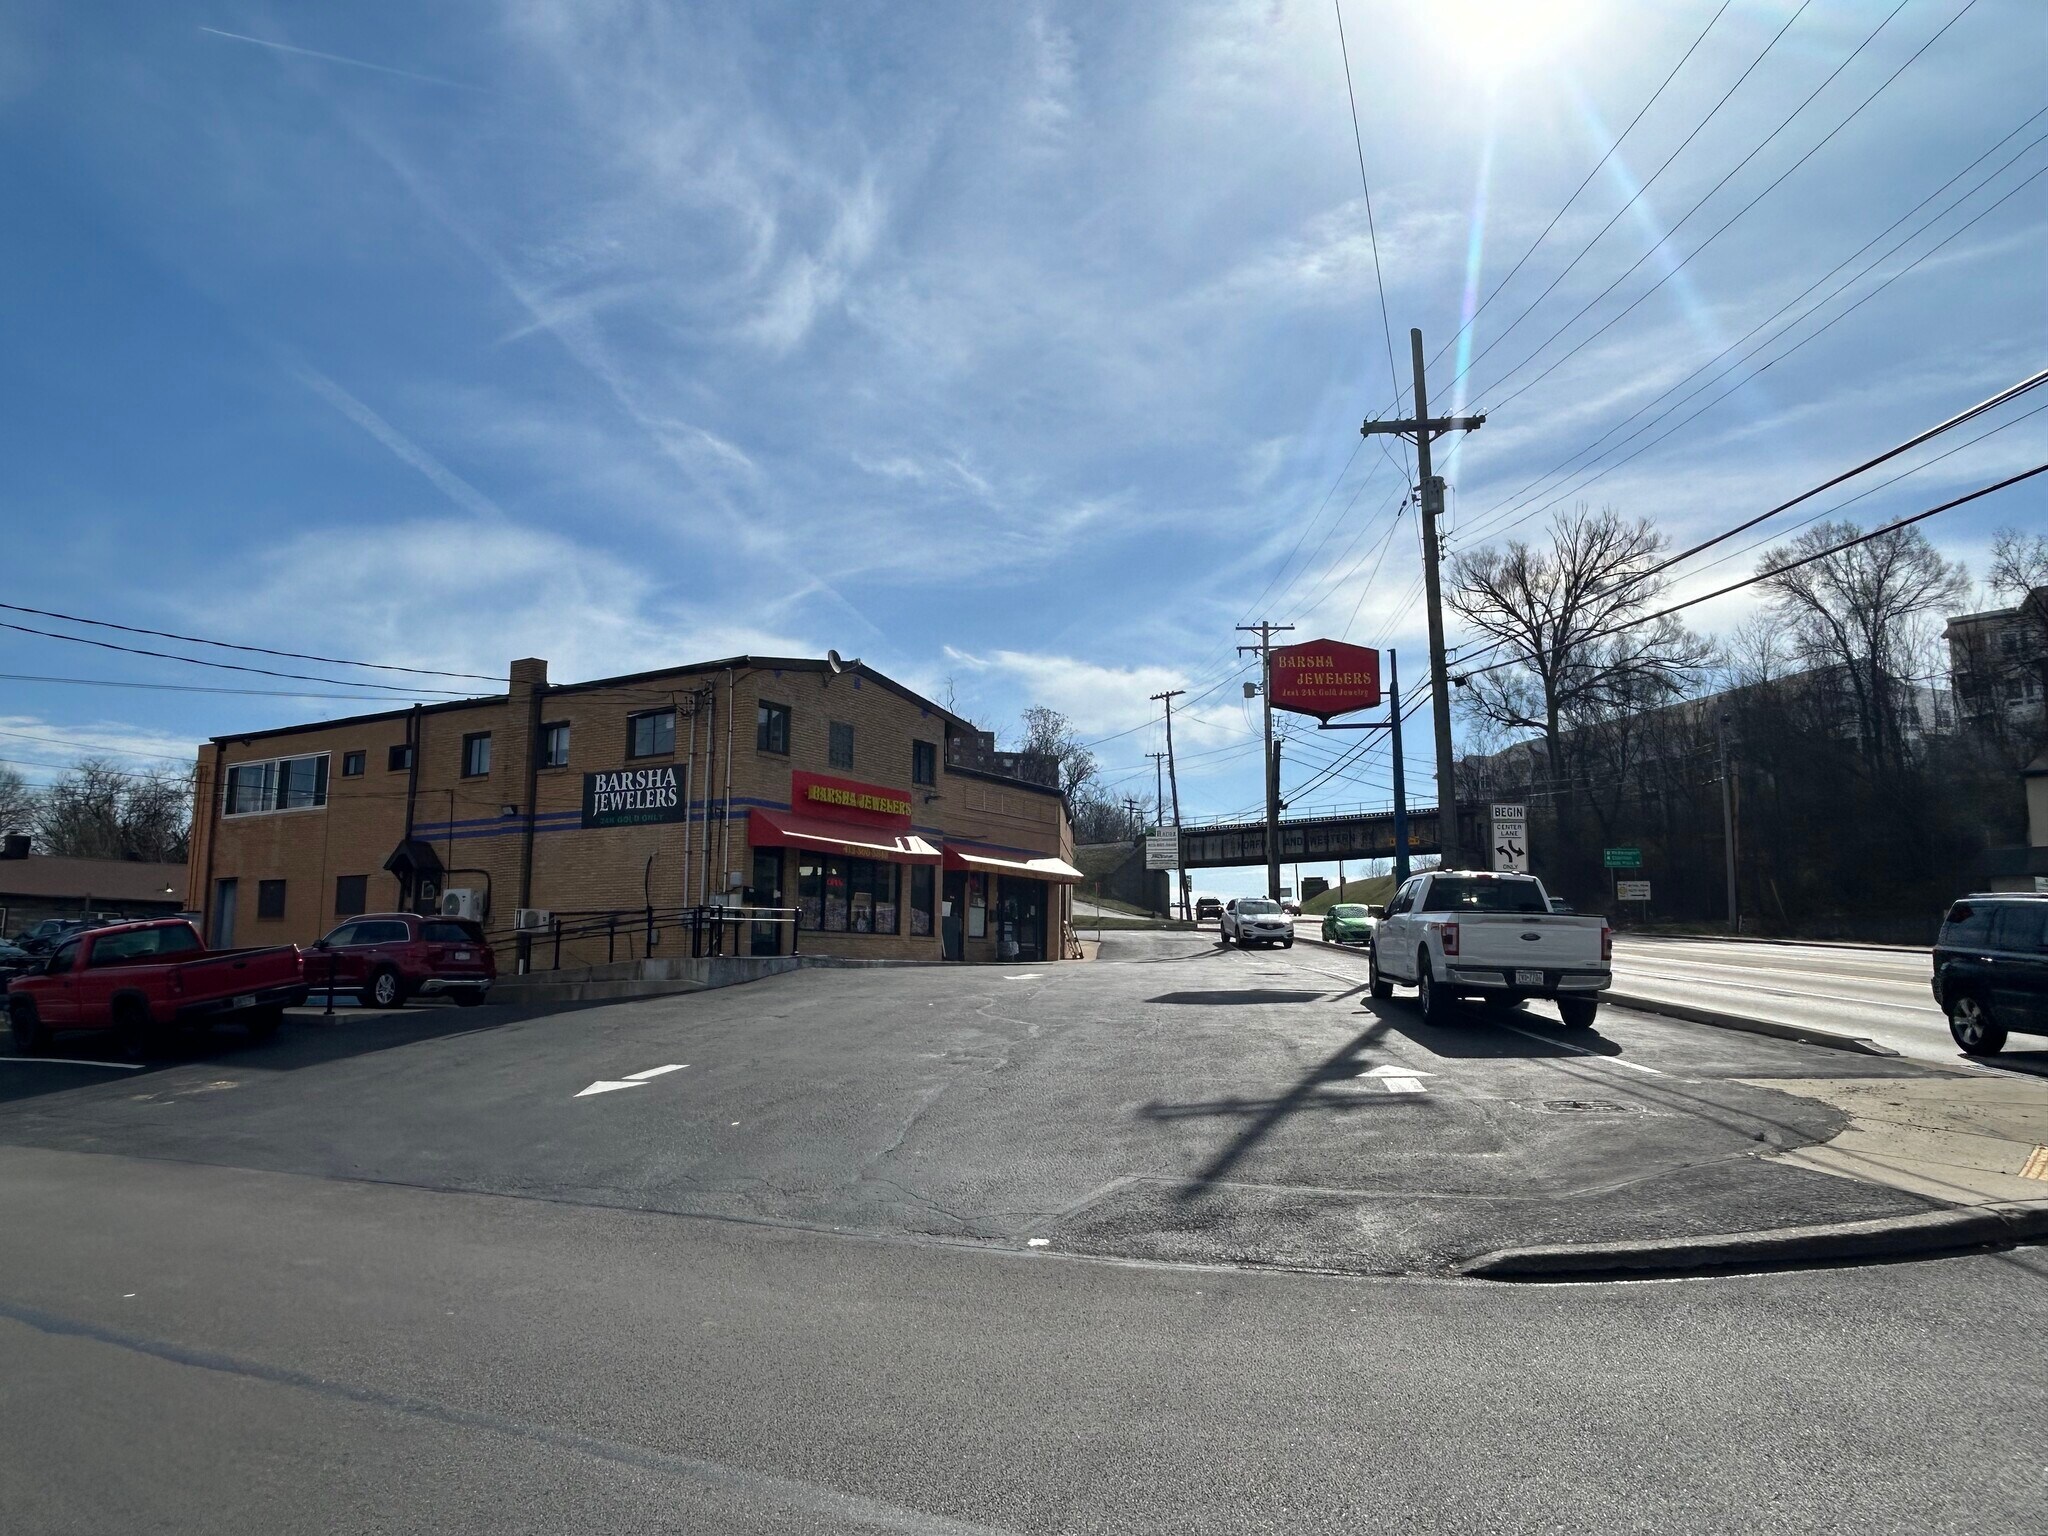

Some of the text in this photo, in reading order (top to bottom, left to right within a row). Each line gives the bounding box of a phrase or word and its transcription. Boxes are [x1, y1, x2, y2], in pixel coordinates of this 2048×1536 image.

[1279, 655, 1334, 668] BARSHA
[1297, 672, 1372, 685] JEWELERS
[594, 767, 677, 793] BARSHA
[593, 787, 678, 817] JEWELERS
[809, 785, 912, 816] BARSHA JEWELERS
[617, 815, 640, 824] GOLD
[642, 814, 665, 822] ONLY
[1494, 807, 1523, 818] BEGIN
[1285, 837, 1303, 846] AND
